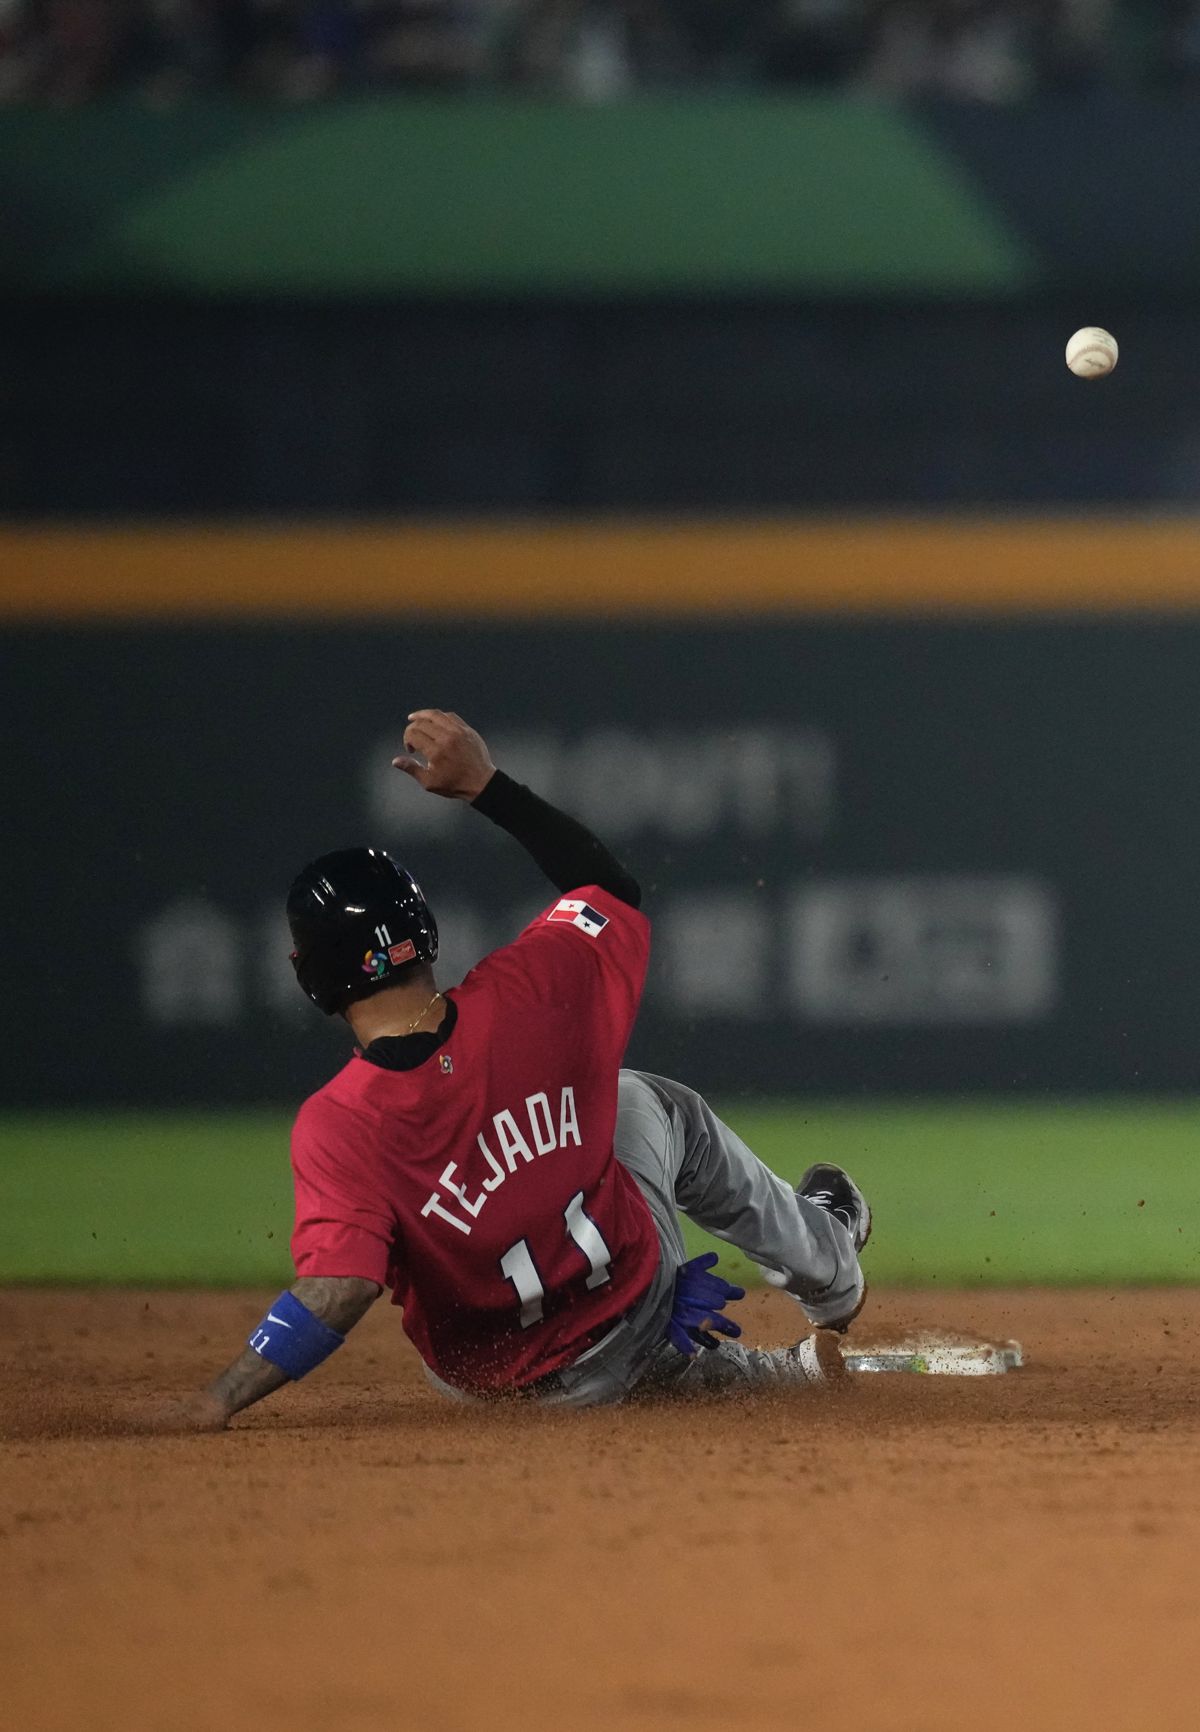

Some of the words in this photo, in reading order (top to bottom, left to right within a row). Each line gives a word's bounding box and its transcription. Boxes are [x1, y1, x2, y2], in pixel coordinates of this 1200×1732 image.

[375, 924, 392, 947] 11
[420, 1086, 582, 1235] TEJADA
[500, 1191, 612, 1329] 11
[249, 1329, 270, 1354] 11
